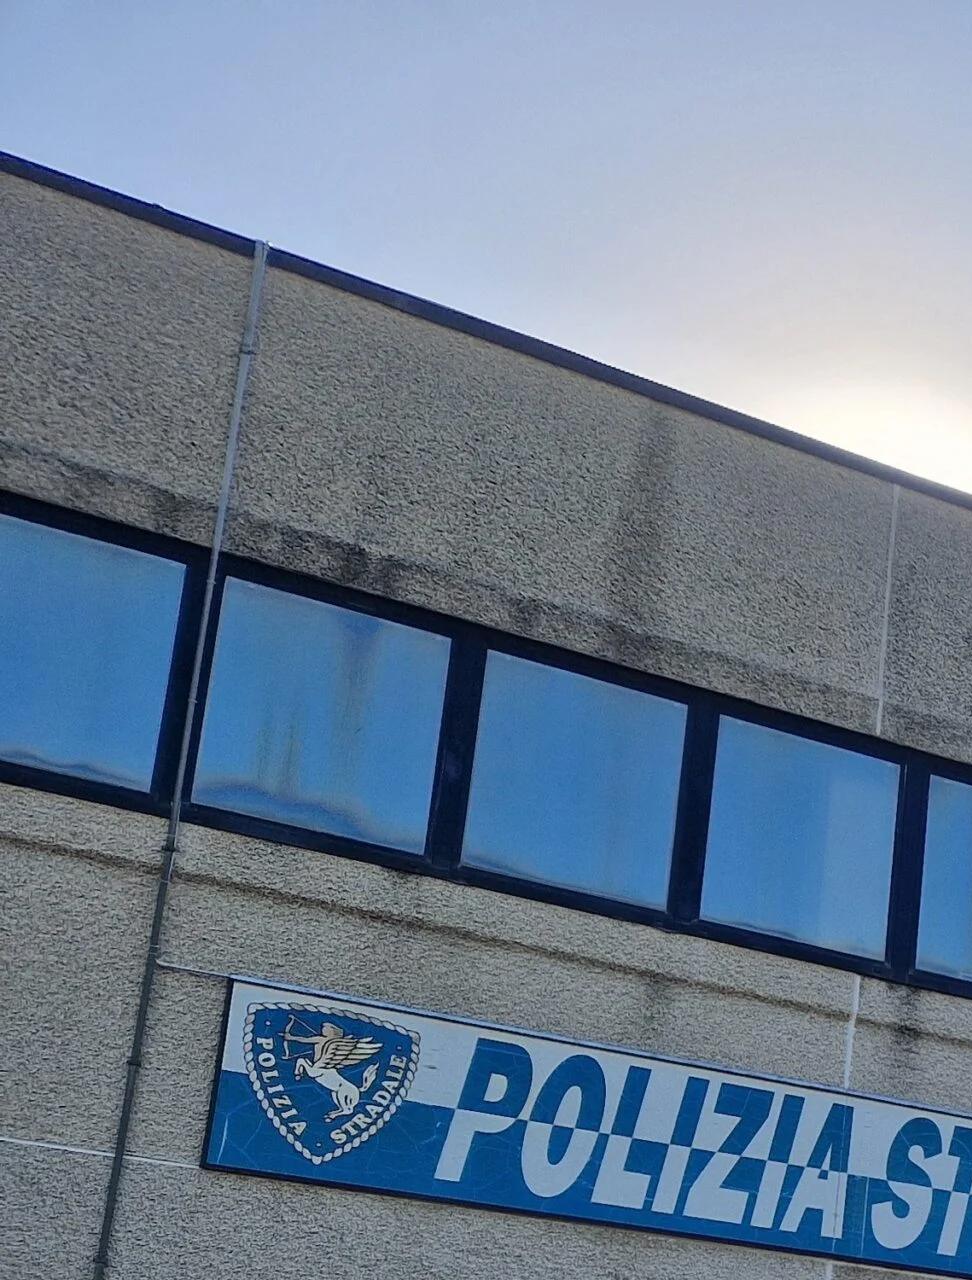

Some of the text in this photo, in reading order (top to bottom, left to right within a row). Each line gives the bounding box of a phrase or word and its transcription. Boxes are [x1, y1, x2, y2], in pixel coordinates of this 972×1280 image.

[256, 1037, 408, 1144] POLIZIA STRADALE
[434, 1038, 854, 1239] POLIZIA
